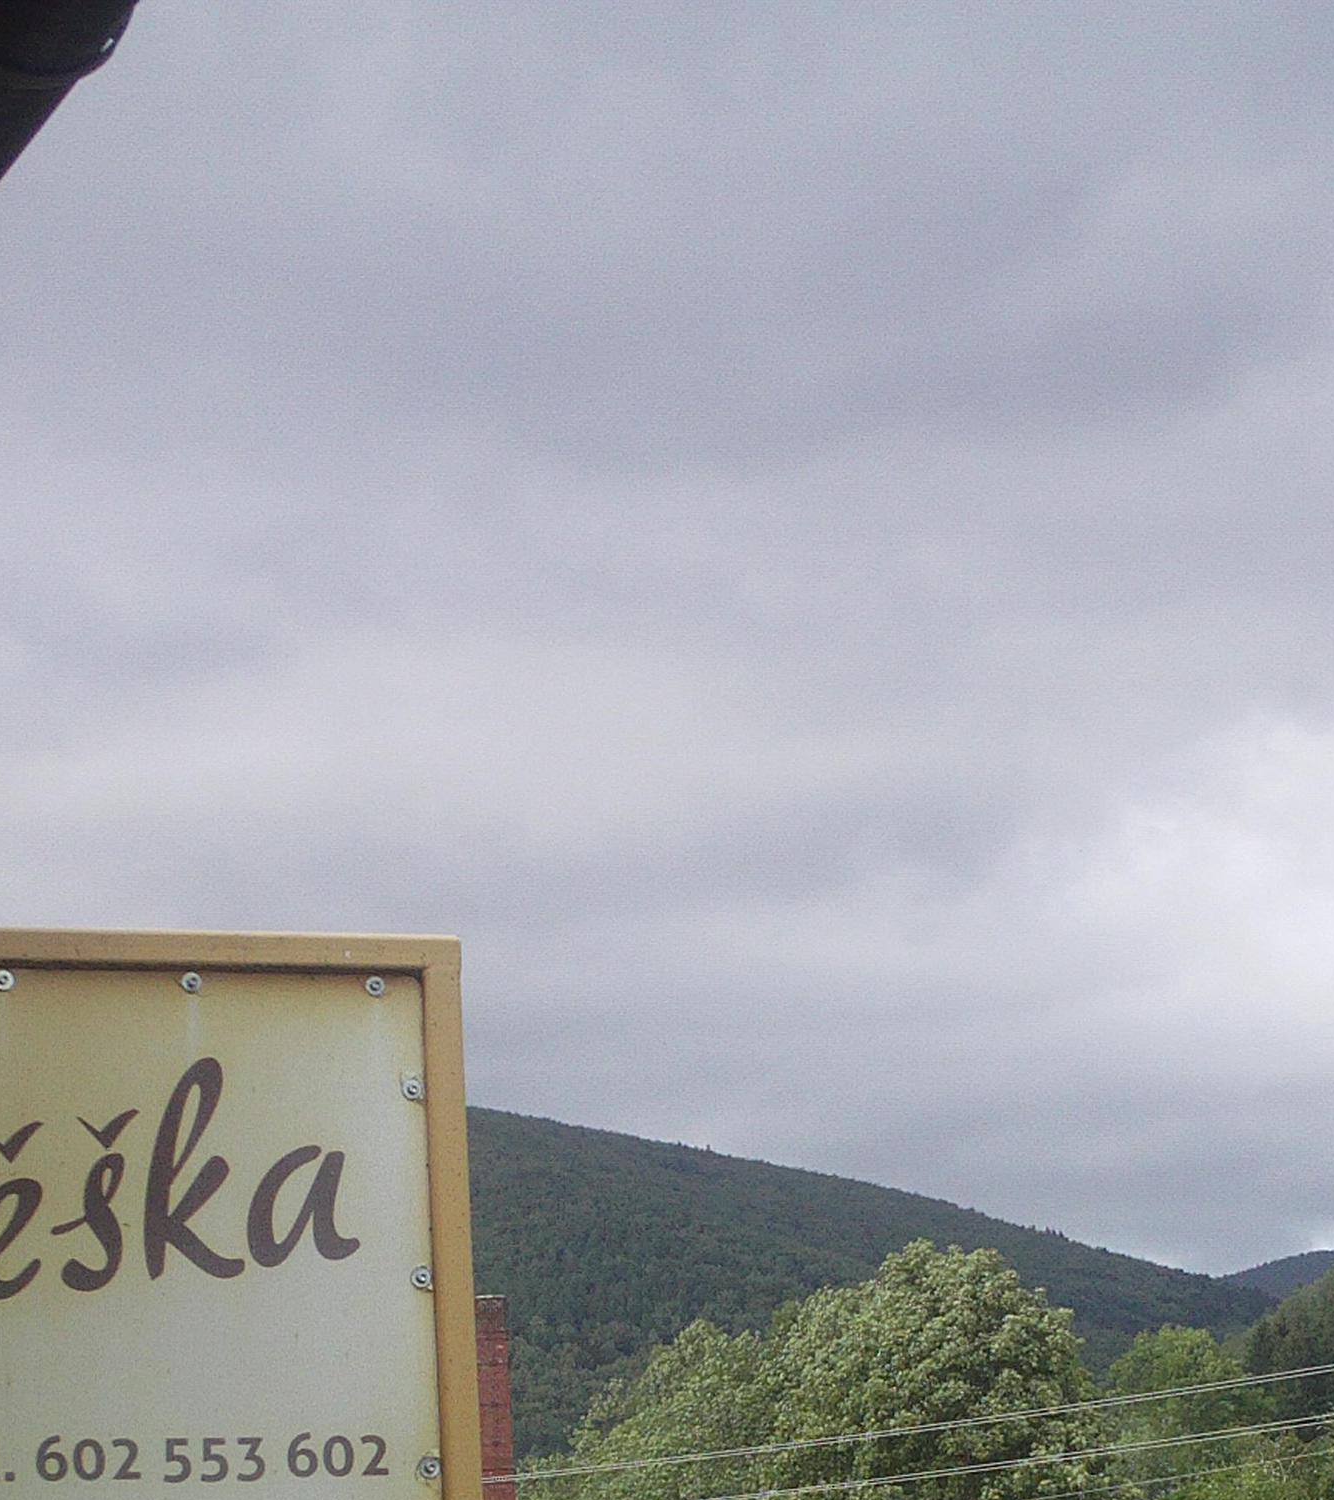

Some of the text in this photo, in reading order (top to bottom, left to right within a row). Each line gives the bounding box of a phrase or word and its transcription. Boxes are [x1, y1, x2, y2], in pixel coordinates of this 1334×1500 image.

[35, 1435, 142, 1482] 602
[163, 1437, 266, 1483] 553
[287, 1432, 390, 1478] 602
